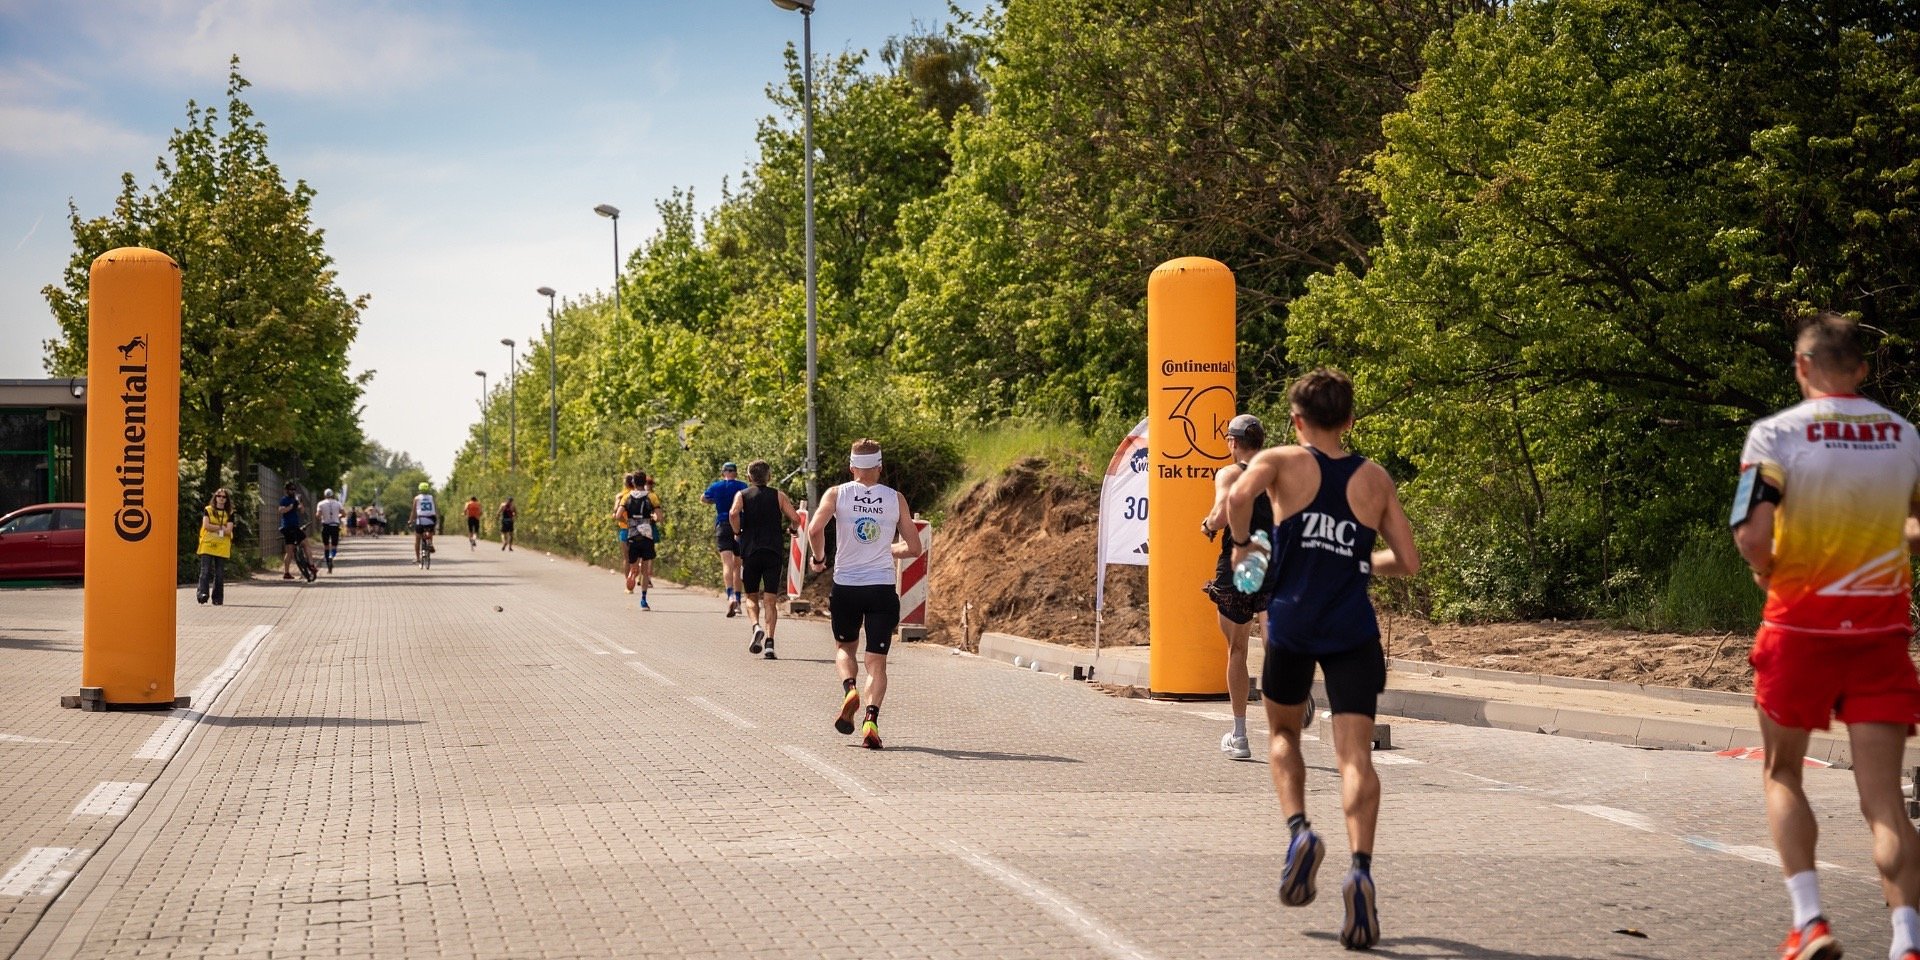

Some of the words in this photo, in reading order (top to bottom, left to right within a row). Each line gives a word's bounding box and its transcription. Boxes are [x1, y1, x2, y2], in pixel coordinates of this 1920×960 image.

[1161, 360, 1231, 376] Continental
[1161, 386, 1236, 460] 30
[1213, 413, 1229, 440] k
[114, 364, 152, 542] Continental
[1158, 465, 1182, 478] Tak
[1187, 466, 1222, 480] trzy
[853, 505, 883, 514] ETRANS
[1124, 496, 1149, 521] 30
[1302, 512, 1357, 547] ZRC
